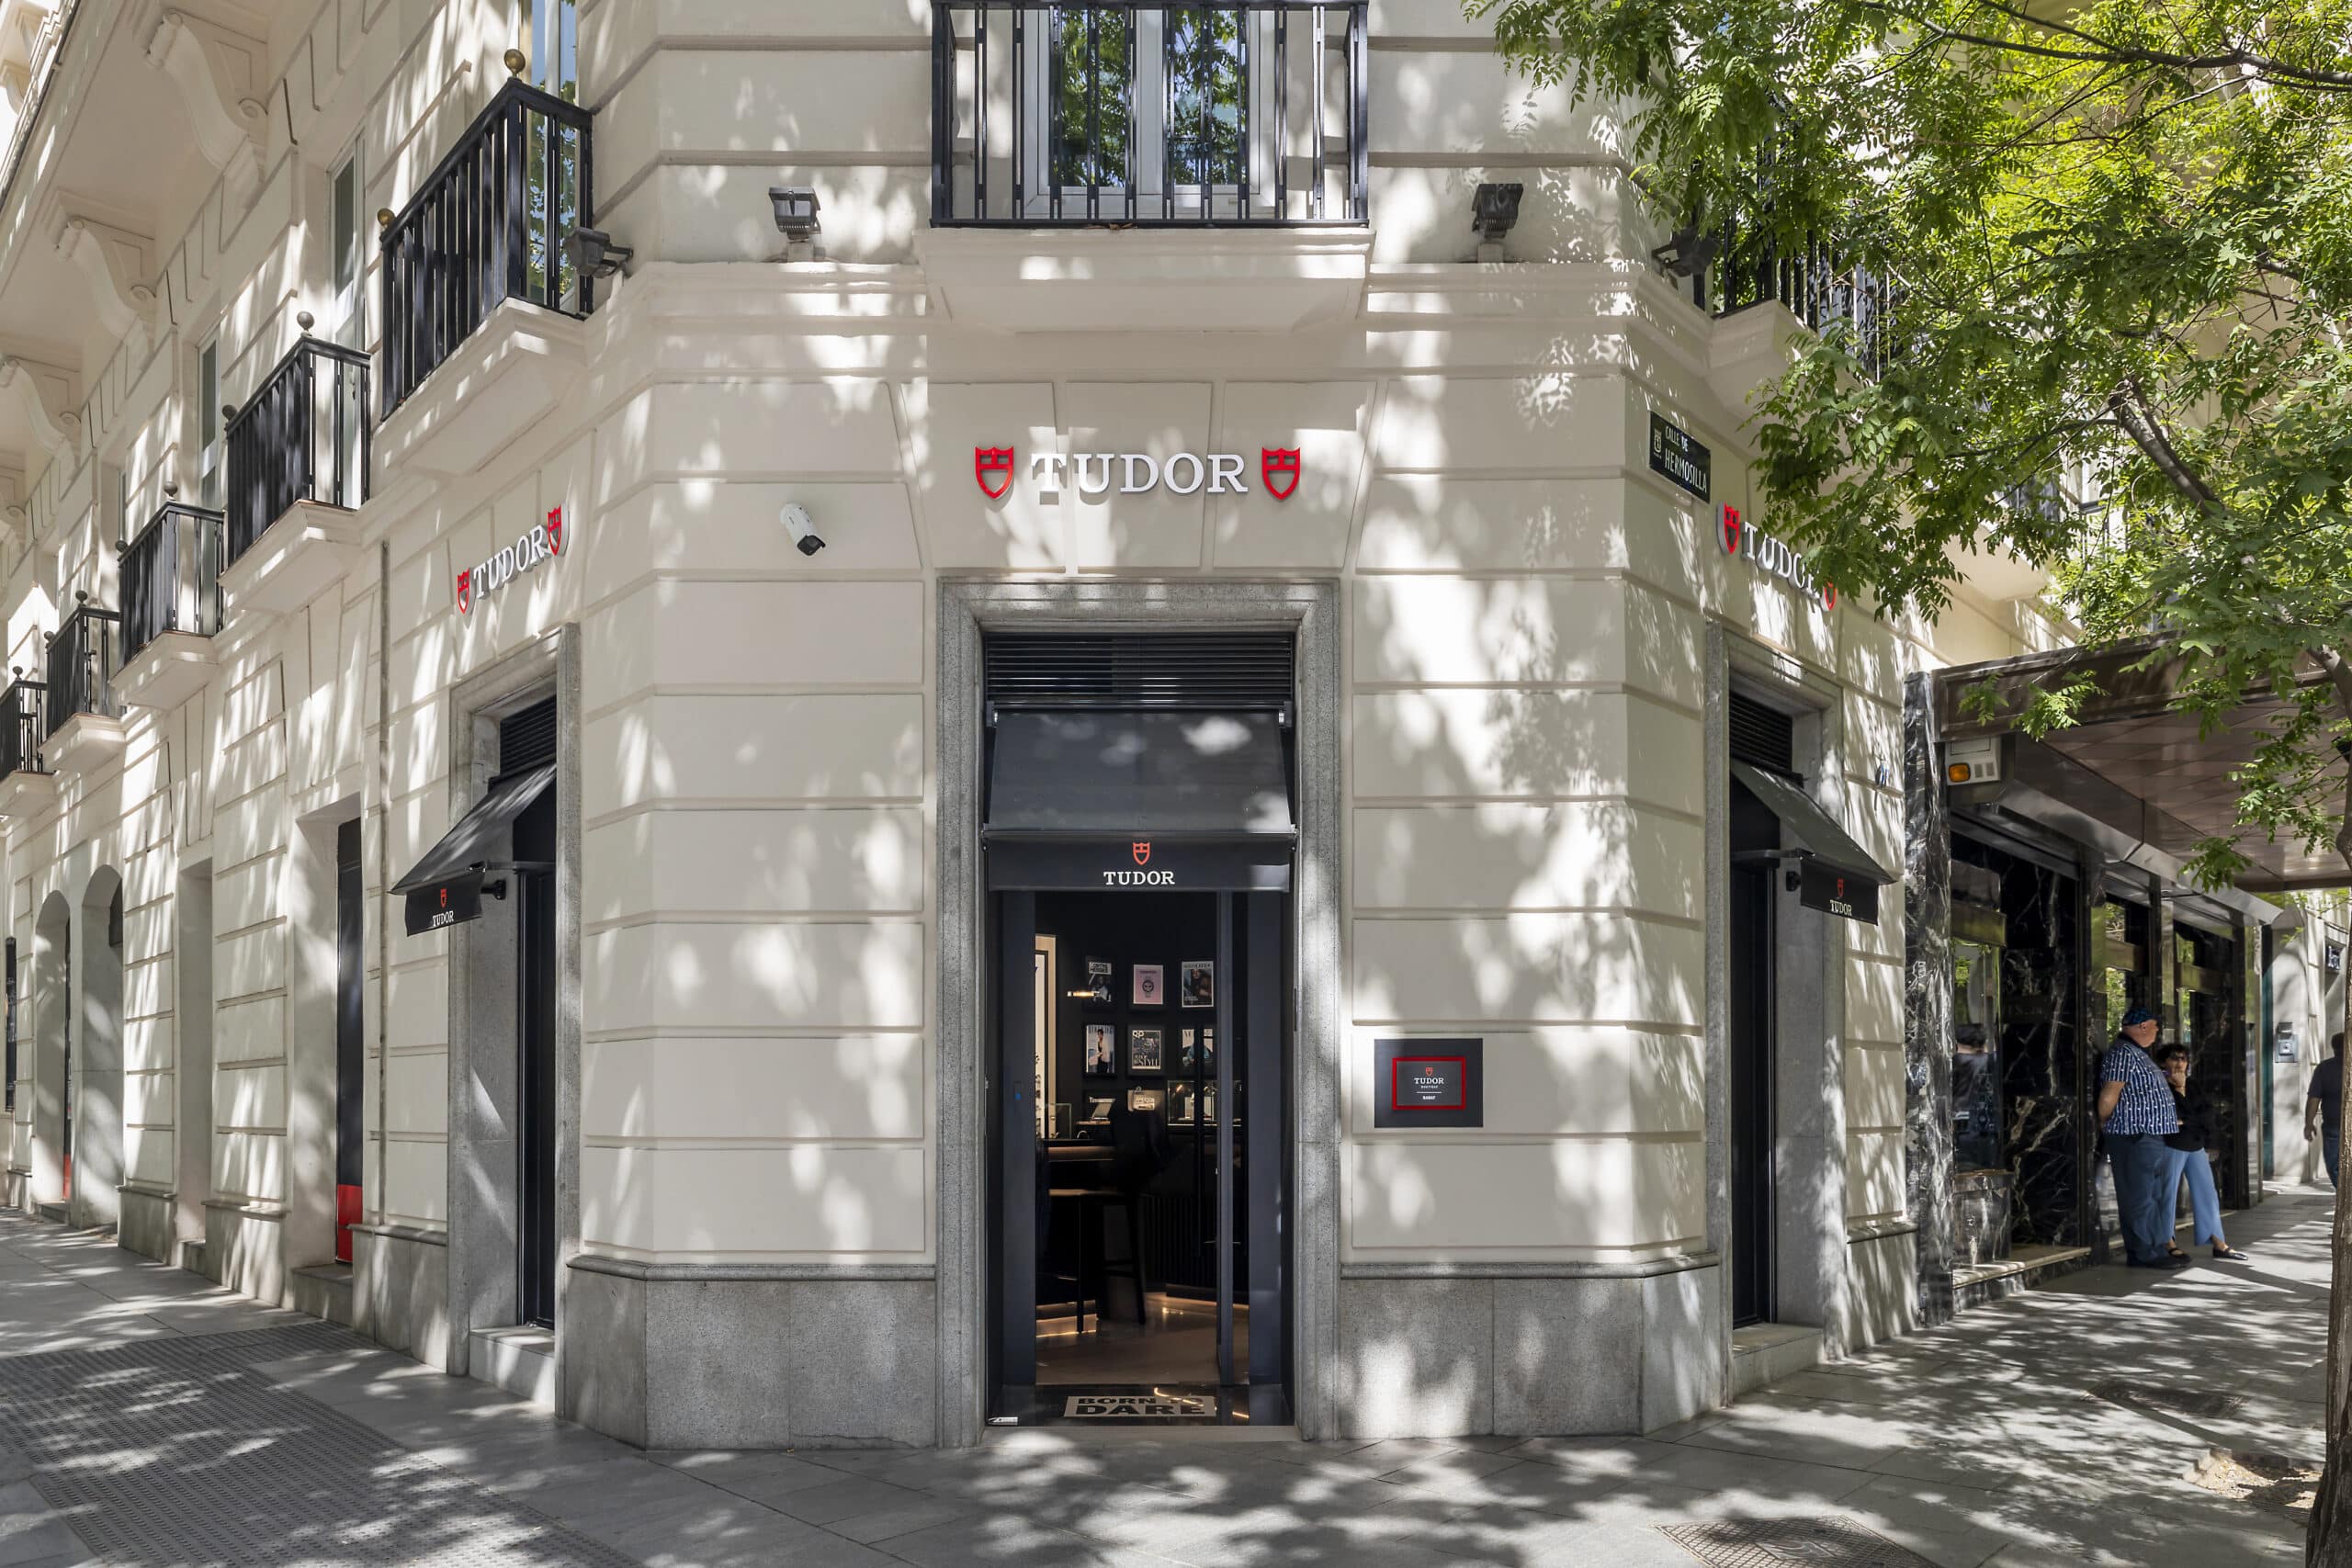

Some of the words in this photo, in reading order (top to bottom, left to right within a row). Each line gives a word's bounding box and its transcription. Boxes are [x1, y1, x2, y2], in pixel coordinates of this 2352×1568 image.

[1665, 425, 1680, 446] CALLE
[1681, 435, 1689, 453] DE
[1031, 453, 1248, 493] TUDOR
[1665, 448, 1707, 493] HERMOSILLA
[473, 525, 551, 598] TUDOR
[1103, 871, 1175, 885] TUDOR
[433, 911, 454, 926] TUDOR
[1829, 899, 1852, 916] TUDOR
[1076, 1405, 1205, 1415] DARE
